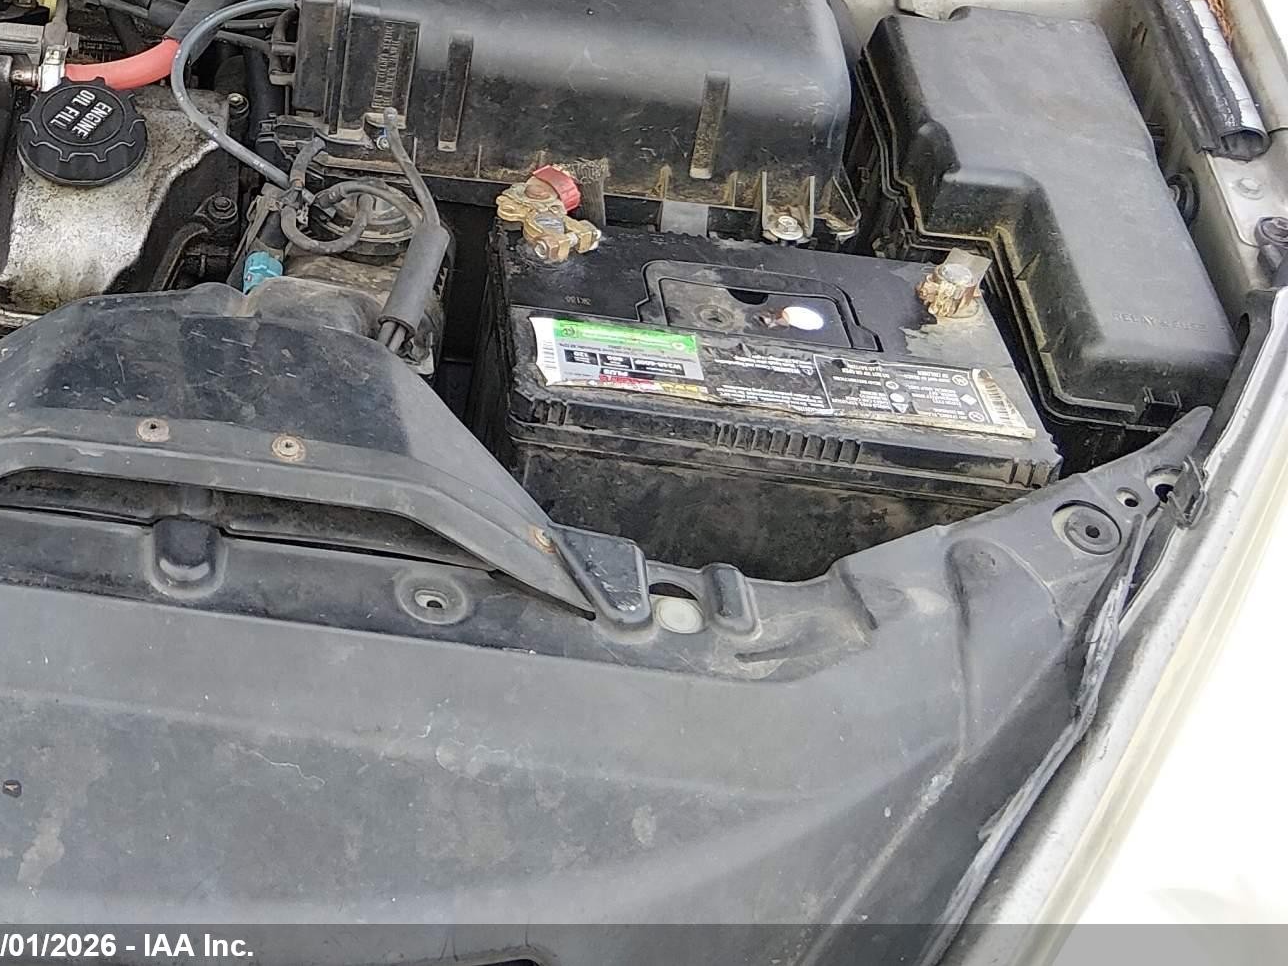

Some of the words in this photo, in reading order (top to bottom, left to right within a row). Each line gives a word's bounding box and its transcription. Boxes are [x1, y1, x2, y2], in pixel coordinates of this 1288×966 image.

[71, 90, 96, 106] OIL
[50, 106, 80, 128] FILL
[72, 102, 112, 137] ENGINE
